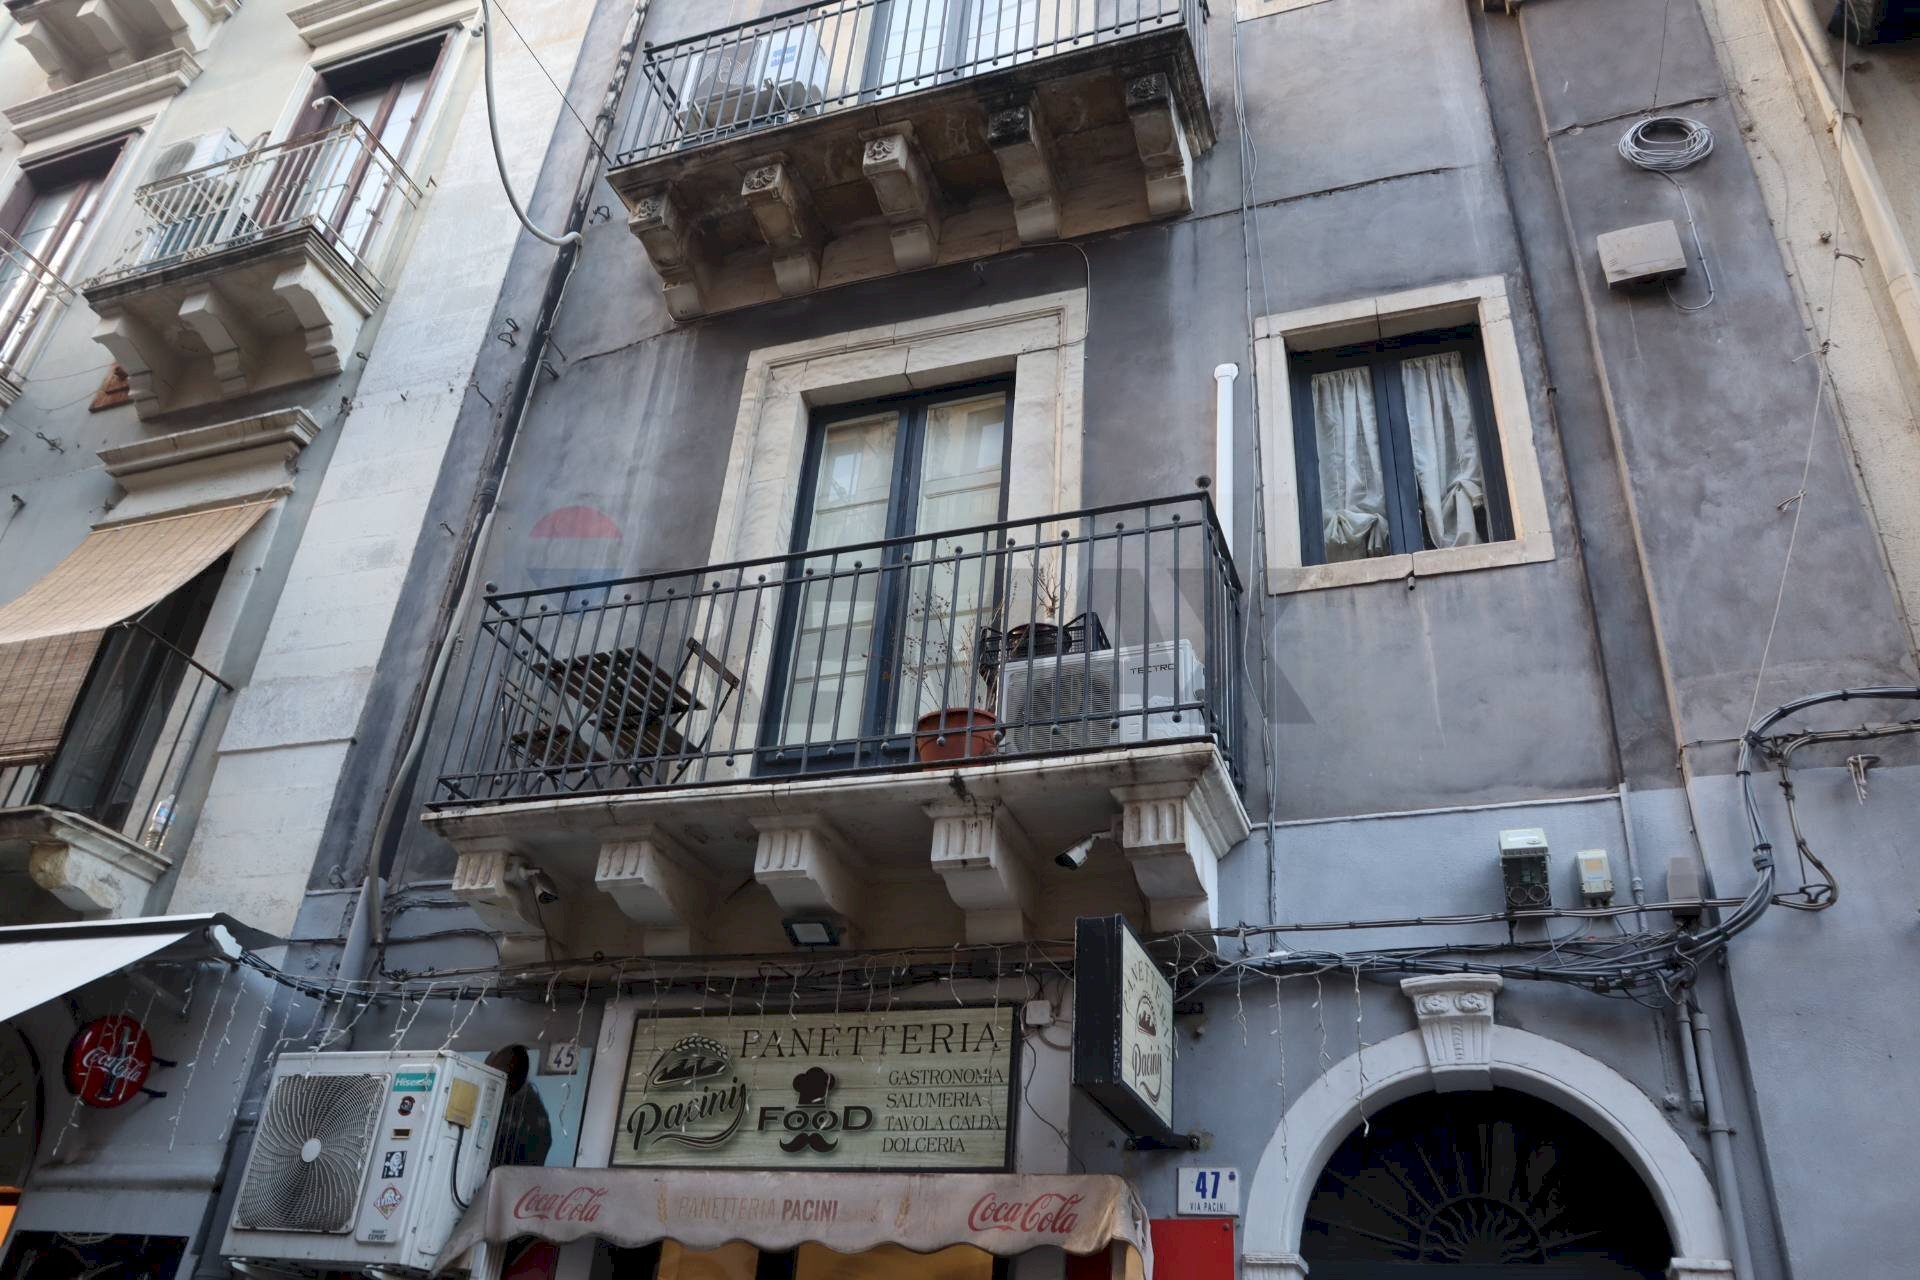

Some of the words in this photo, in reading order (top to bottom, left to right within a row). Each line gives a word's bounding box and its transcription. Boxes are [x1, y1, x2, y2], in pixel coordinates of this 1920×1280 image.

[740, 1023, 1001, 1058] PANETTERIA
[553, 1046, 575, 1068] 45
[888, 1068, 1004, 1086] GASTRONOMIA
[886, 1091, 982, 1108] SALUMERIA
[627, 1077, 746, 1151] Pacini
[885, 1115, 945, 1131] TAVOLA
[949, 1114, 1001, 1131] CALDA
[882, 1137, 966, 1153] DOLCERIA
[1195, 1171, 1221, 1199] 47
[781, 1199, 838, 1221] PACINI
[1190, 1202, 1201, 1211] VIA
[1203, 1202, 1227, 1212] PACINI
